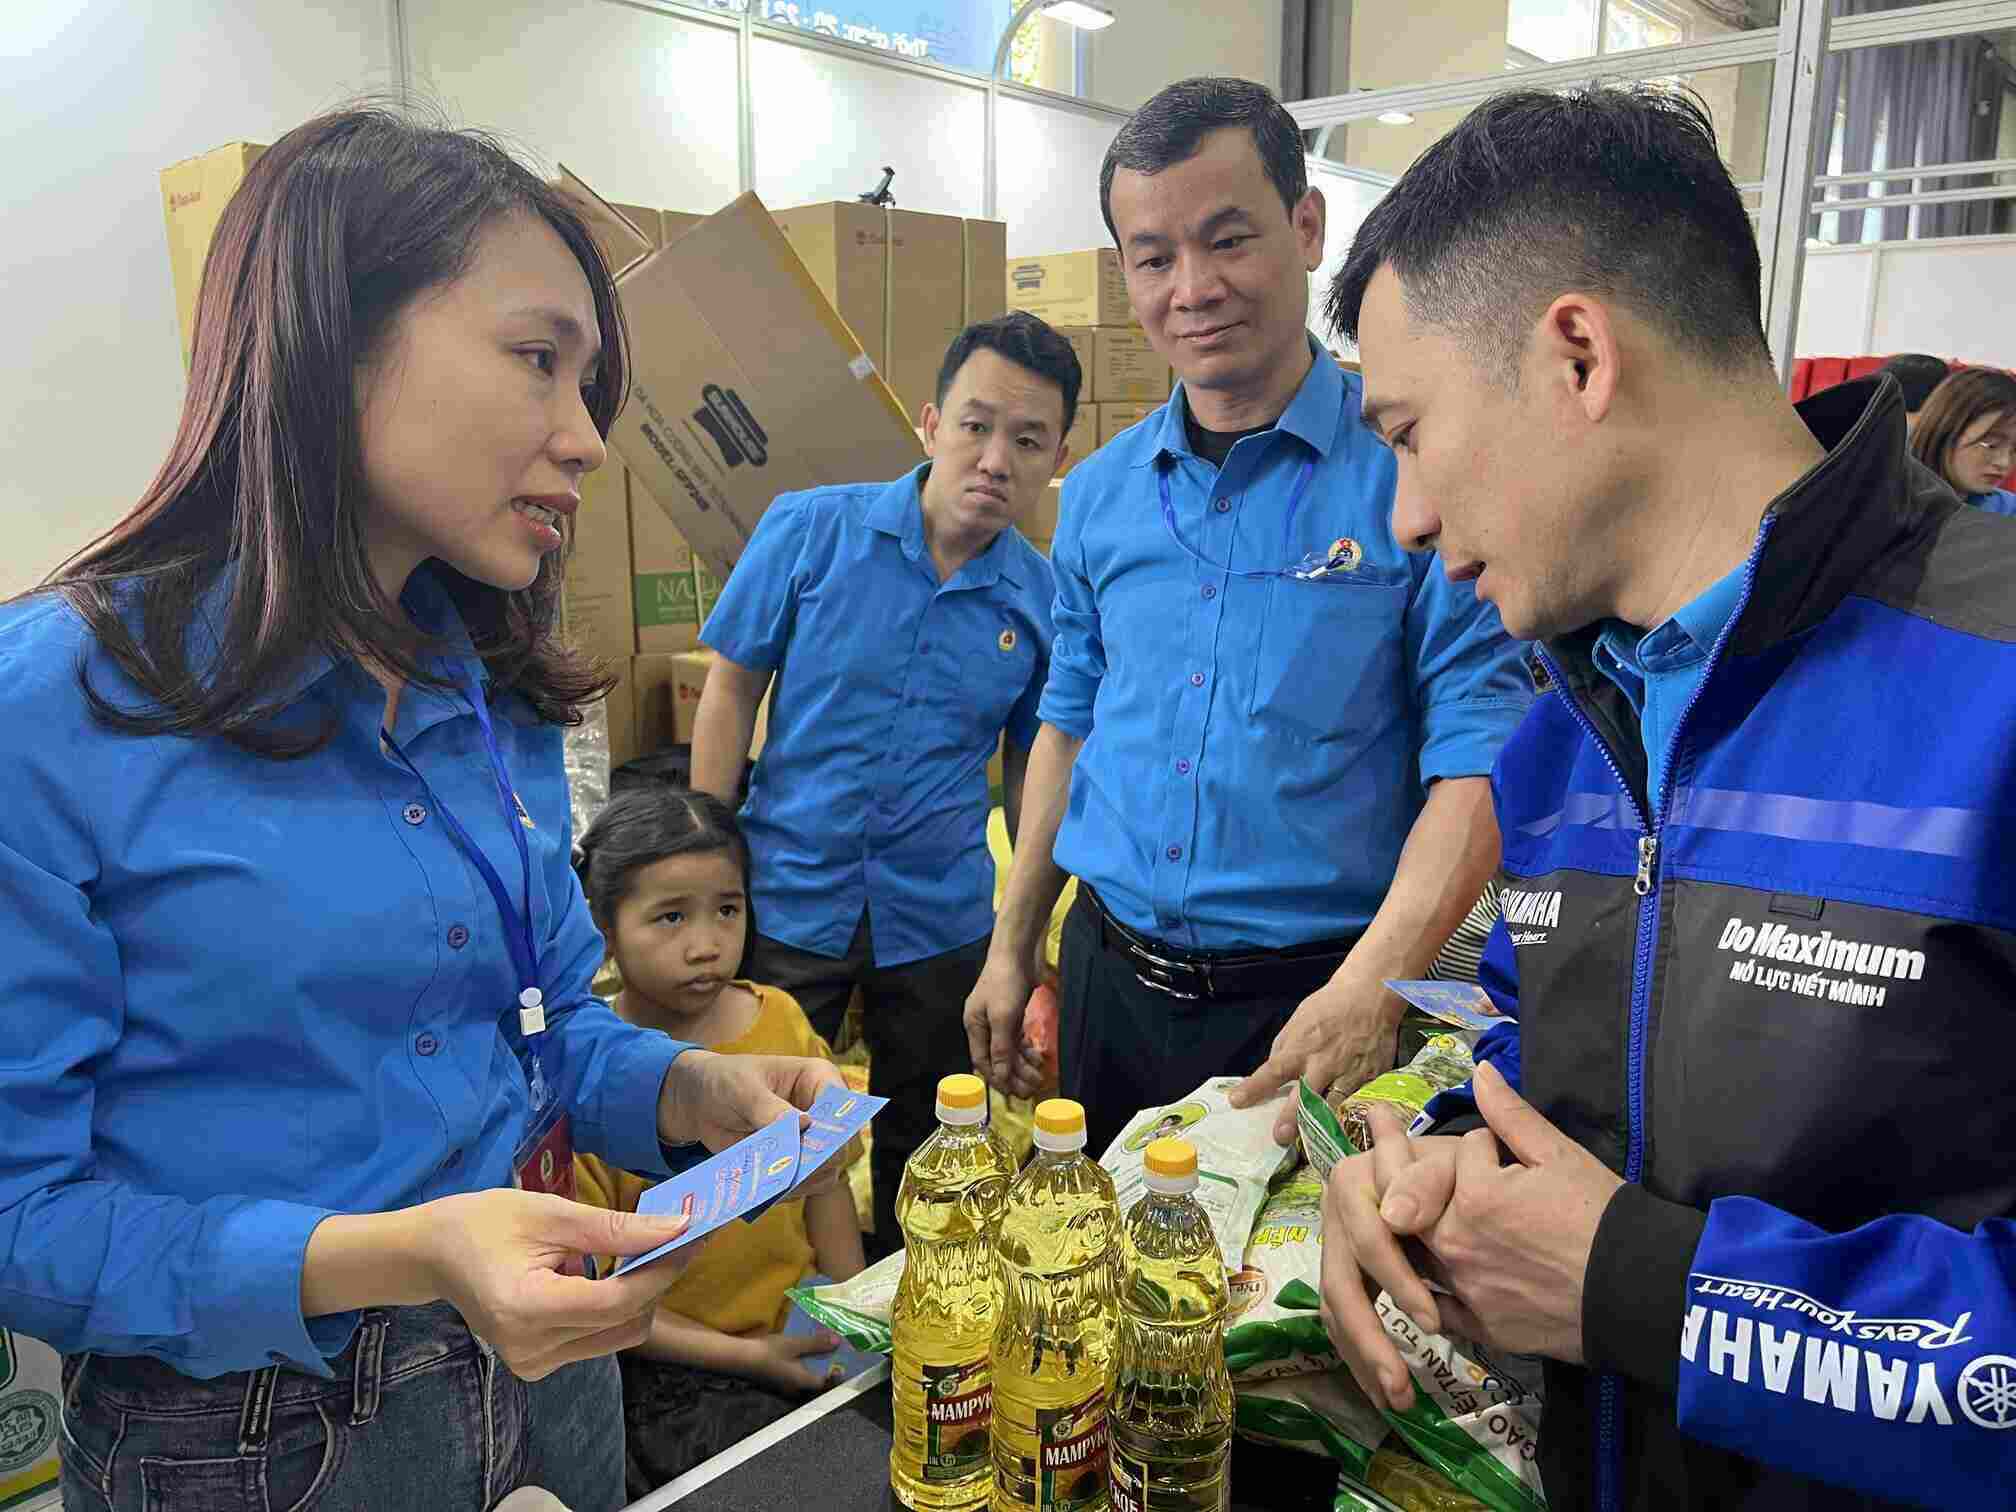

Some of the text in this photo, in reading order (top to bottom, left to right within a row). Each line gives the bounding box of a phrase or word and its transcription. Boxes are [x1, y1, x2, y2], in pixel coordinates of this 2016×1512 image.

[1695, 1279, 1973, 1350] Revs Your Heart
[1421, 1348, 1458, 1392] TAN
[1681, 1304, 1953, 1425] YAMAHA
